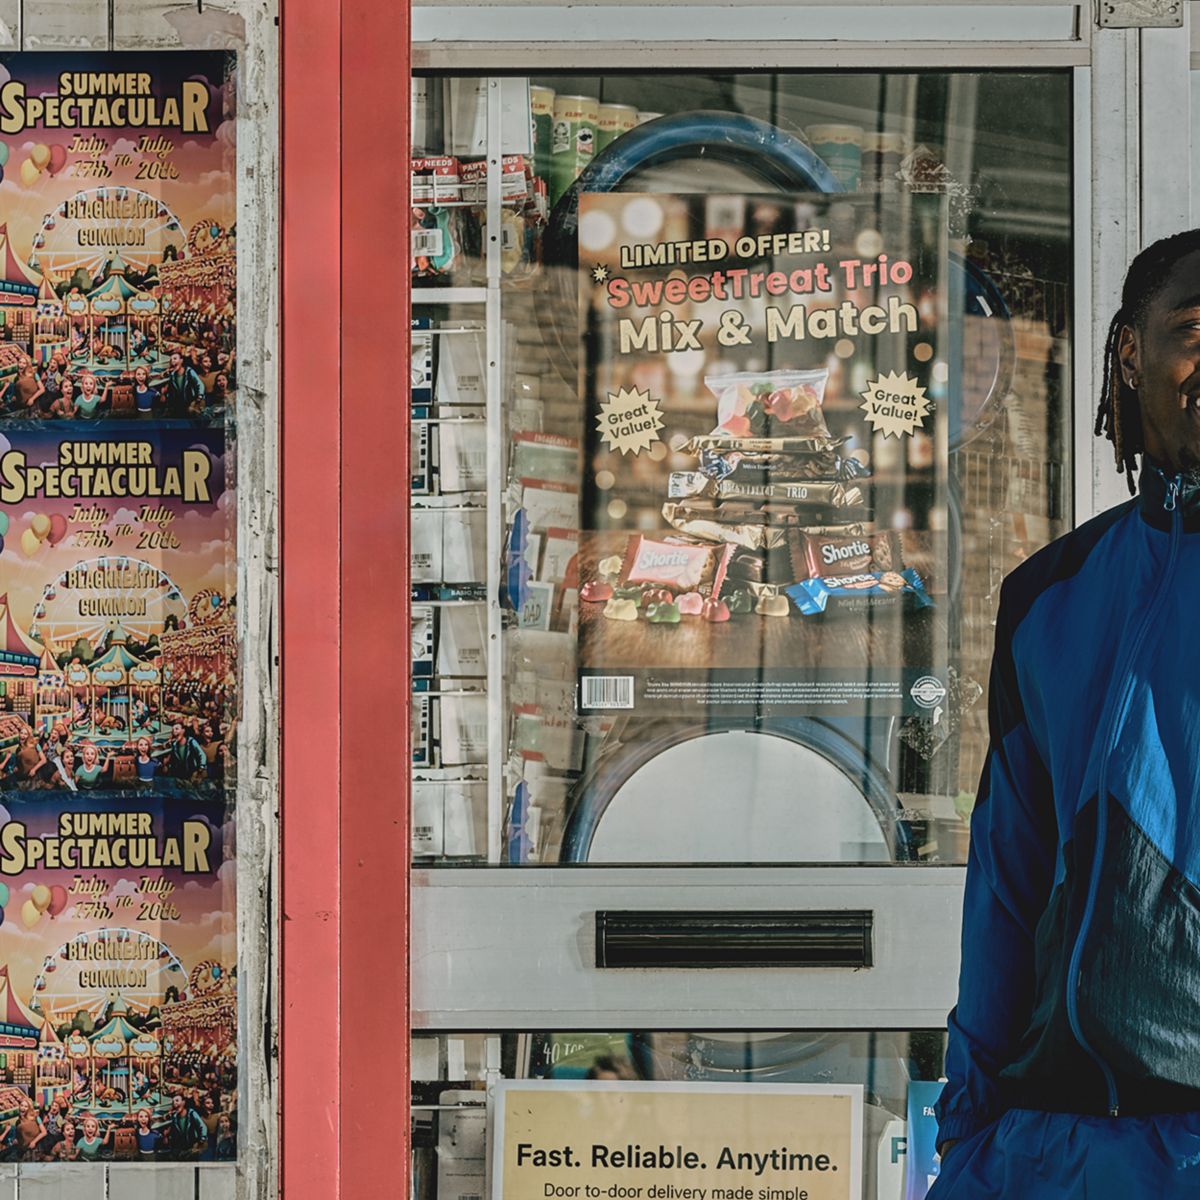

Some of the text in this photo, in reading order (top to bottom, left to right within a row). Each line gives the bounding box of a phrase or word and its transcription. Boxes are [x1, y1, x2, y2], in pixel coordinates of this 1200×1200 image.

[60, 72, 152, 96] SUMMER
[1, 81, 209, 132] SPECTACULAR
[68, 134, 174, 159] July July
[620, 229, 831, 269] LIMITED OFFER!
[606, 254, 914, 309] SweetTreat Trio
[618, 297, 919, 354] Mix & Match
[874, 388, 917, 407] Great
[607, 404, 649, 427] Great
[871, 402, 918, 423] Value!
[610, 418, 657, 441] Value!
[60, 442, 152, 465] SUMMER
[1, 450, 210, 503] SPECTACULAR
[68, 503, 175, 529] July July
[821, 539, 872, 565] Shortie
[60, 813, 152, 836] SUMMER
[1, 821, 210, 873] SPECTACULAR
[68, 874, 175, 901] July July
[517, 1143, 838, 1176] Fast. Reliable. Anytime.
[543, 1182, 581, 1198] Door
[584, 1183, 644, 1200] to-door
[711, 1186, 754, 1200] made
